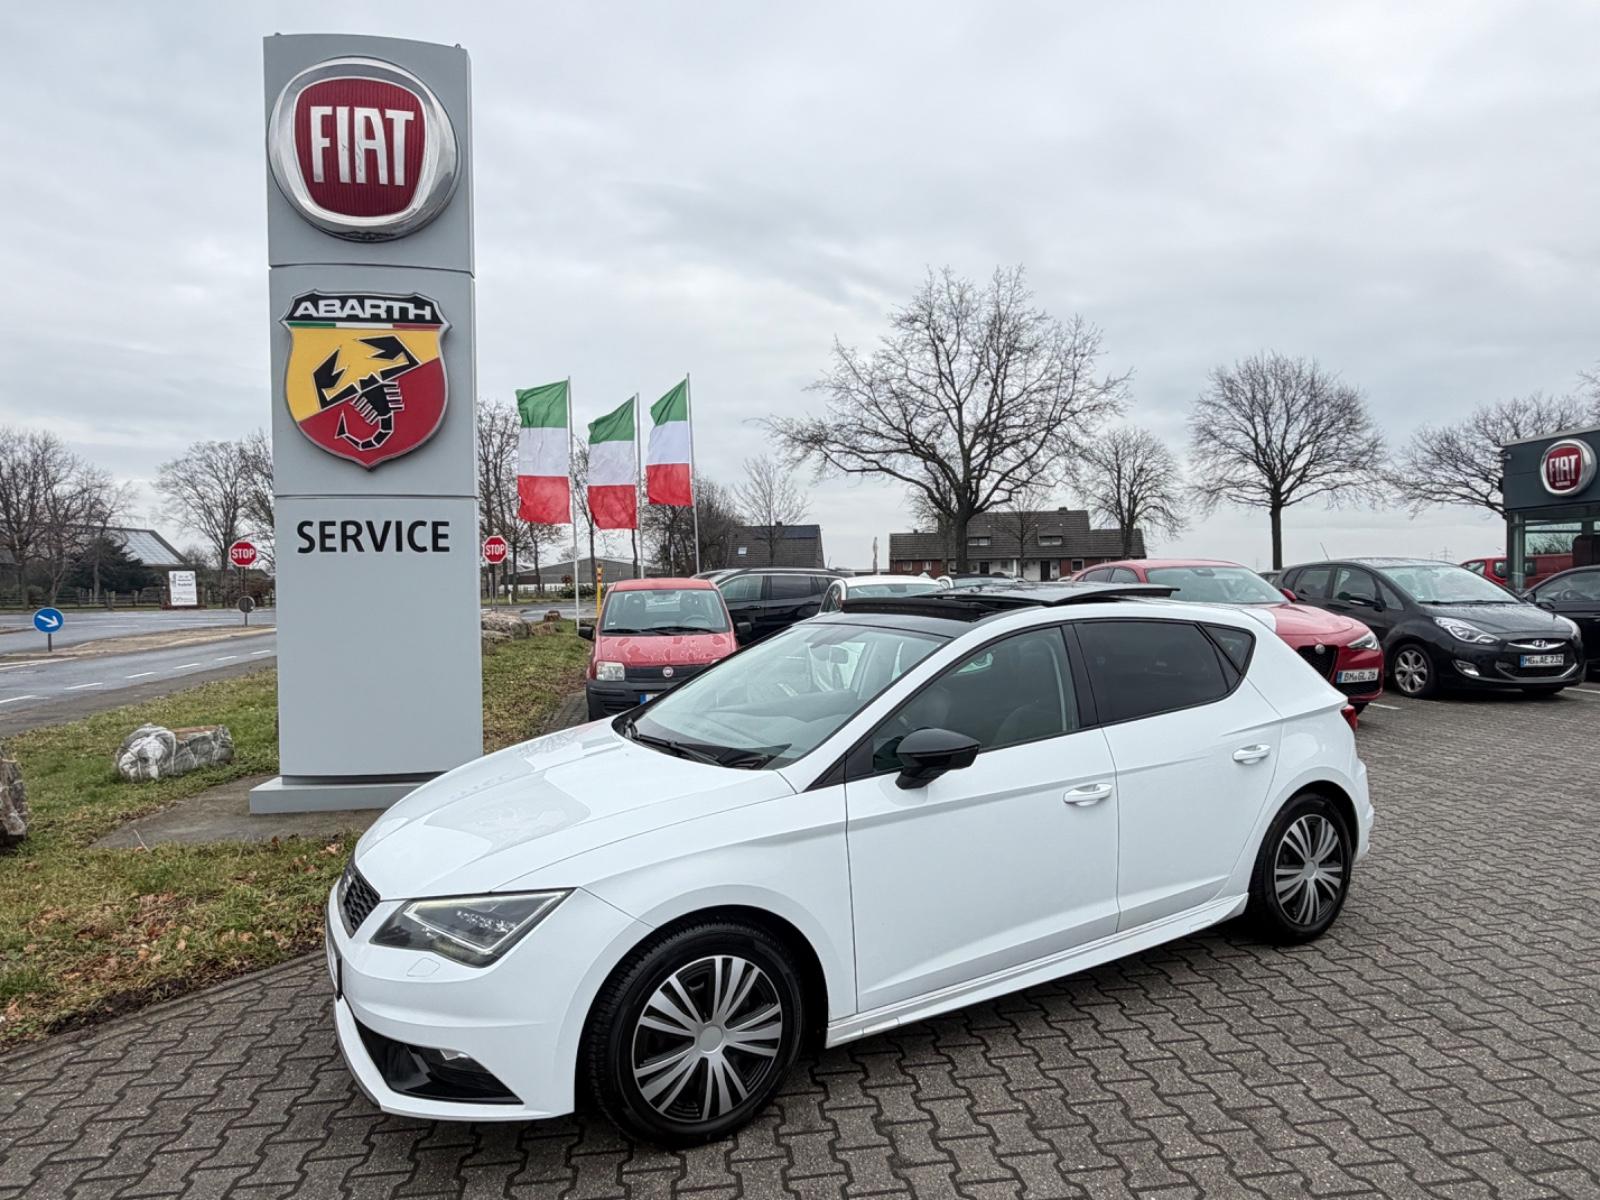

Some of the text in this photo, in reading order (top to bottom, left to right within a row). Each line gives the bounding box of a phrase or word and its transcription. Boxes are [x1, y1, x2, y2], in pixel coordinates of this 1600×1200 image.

[310, 105, 414, 186] FIAT
[293, 299, 432, 320] ABARTH
[1549, 454, 1579, 482] FIAT
[297, 520, 450, 554] SERVICE
[231, 548, 255, 559] STOP
[485, 544, 505, 556] STOP
